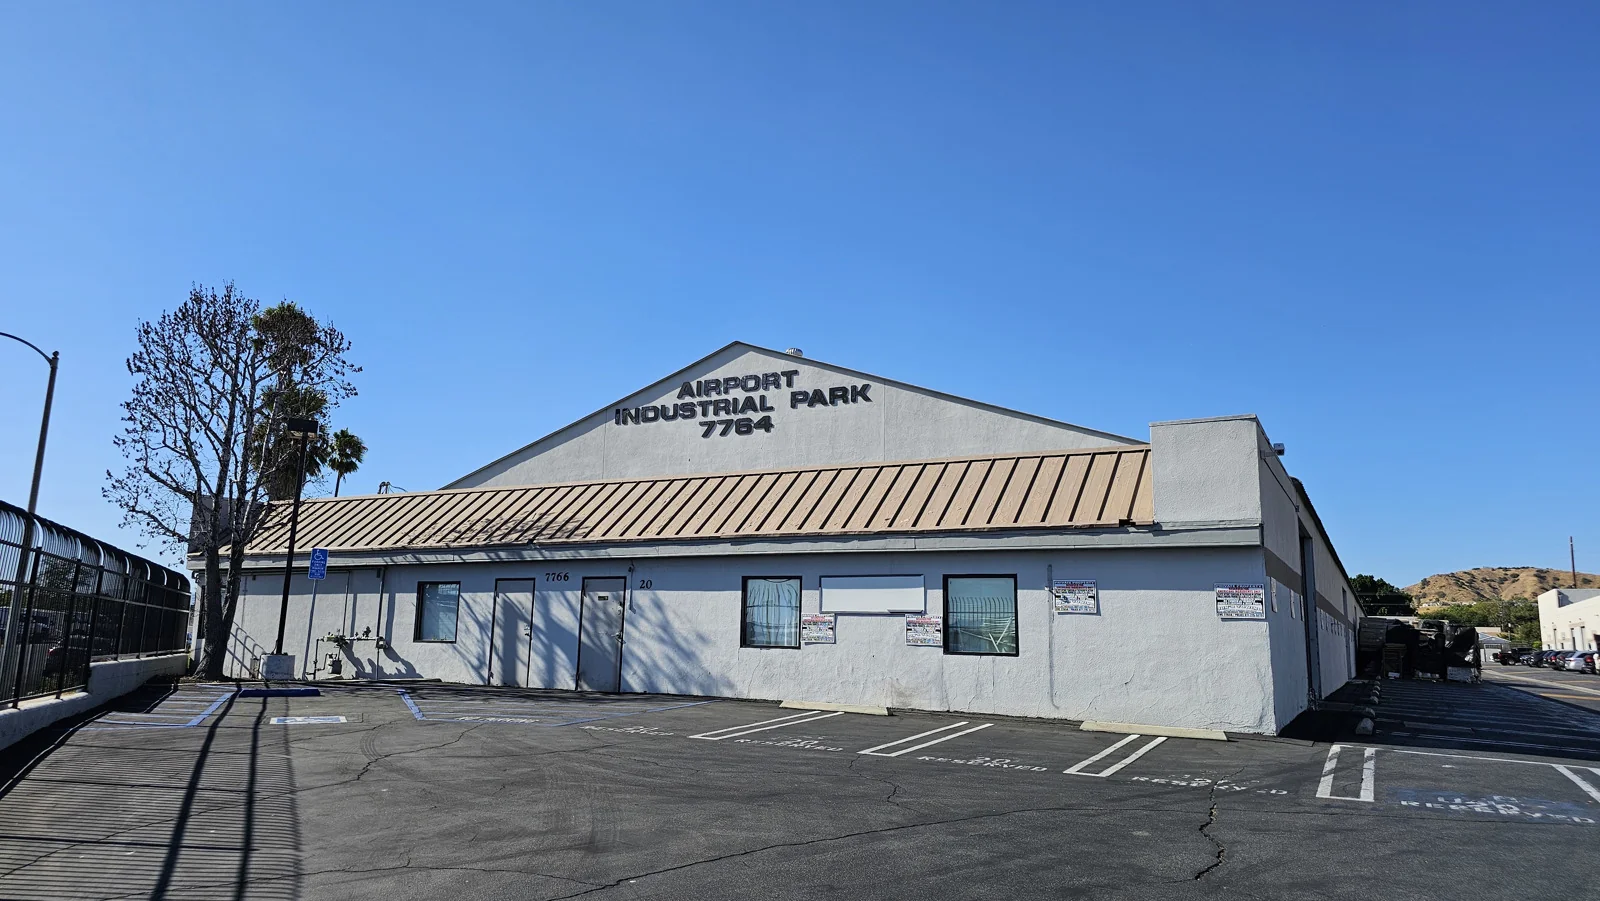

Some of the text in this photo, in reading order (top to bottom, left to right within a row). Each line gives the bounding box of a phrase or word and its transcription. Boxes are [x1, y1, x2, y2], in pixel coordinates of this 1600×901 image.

[677, 370, 799, 400] AIRPORT
[614, 383, 873, 426] INDUSTRIAL PARK
[699, 415, 775, 439] 7764
[545, 572, 570, 582] 7766
[639, 580, 653, 590] 20
[917, 756, 1048, 771] RESERVED
[1400, 800, 1596, 824] RESERVED
